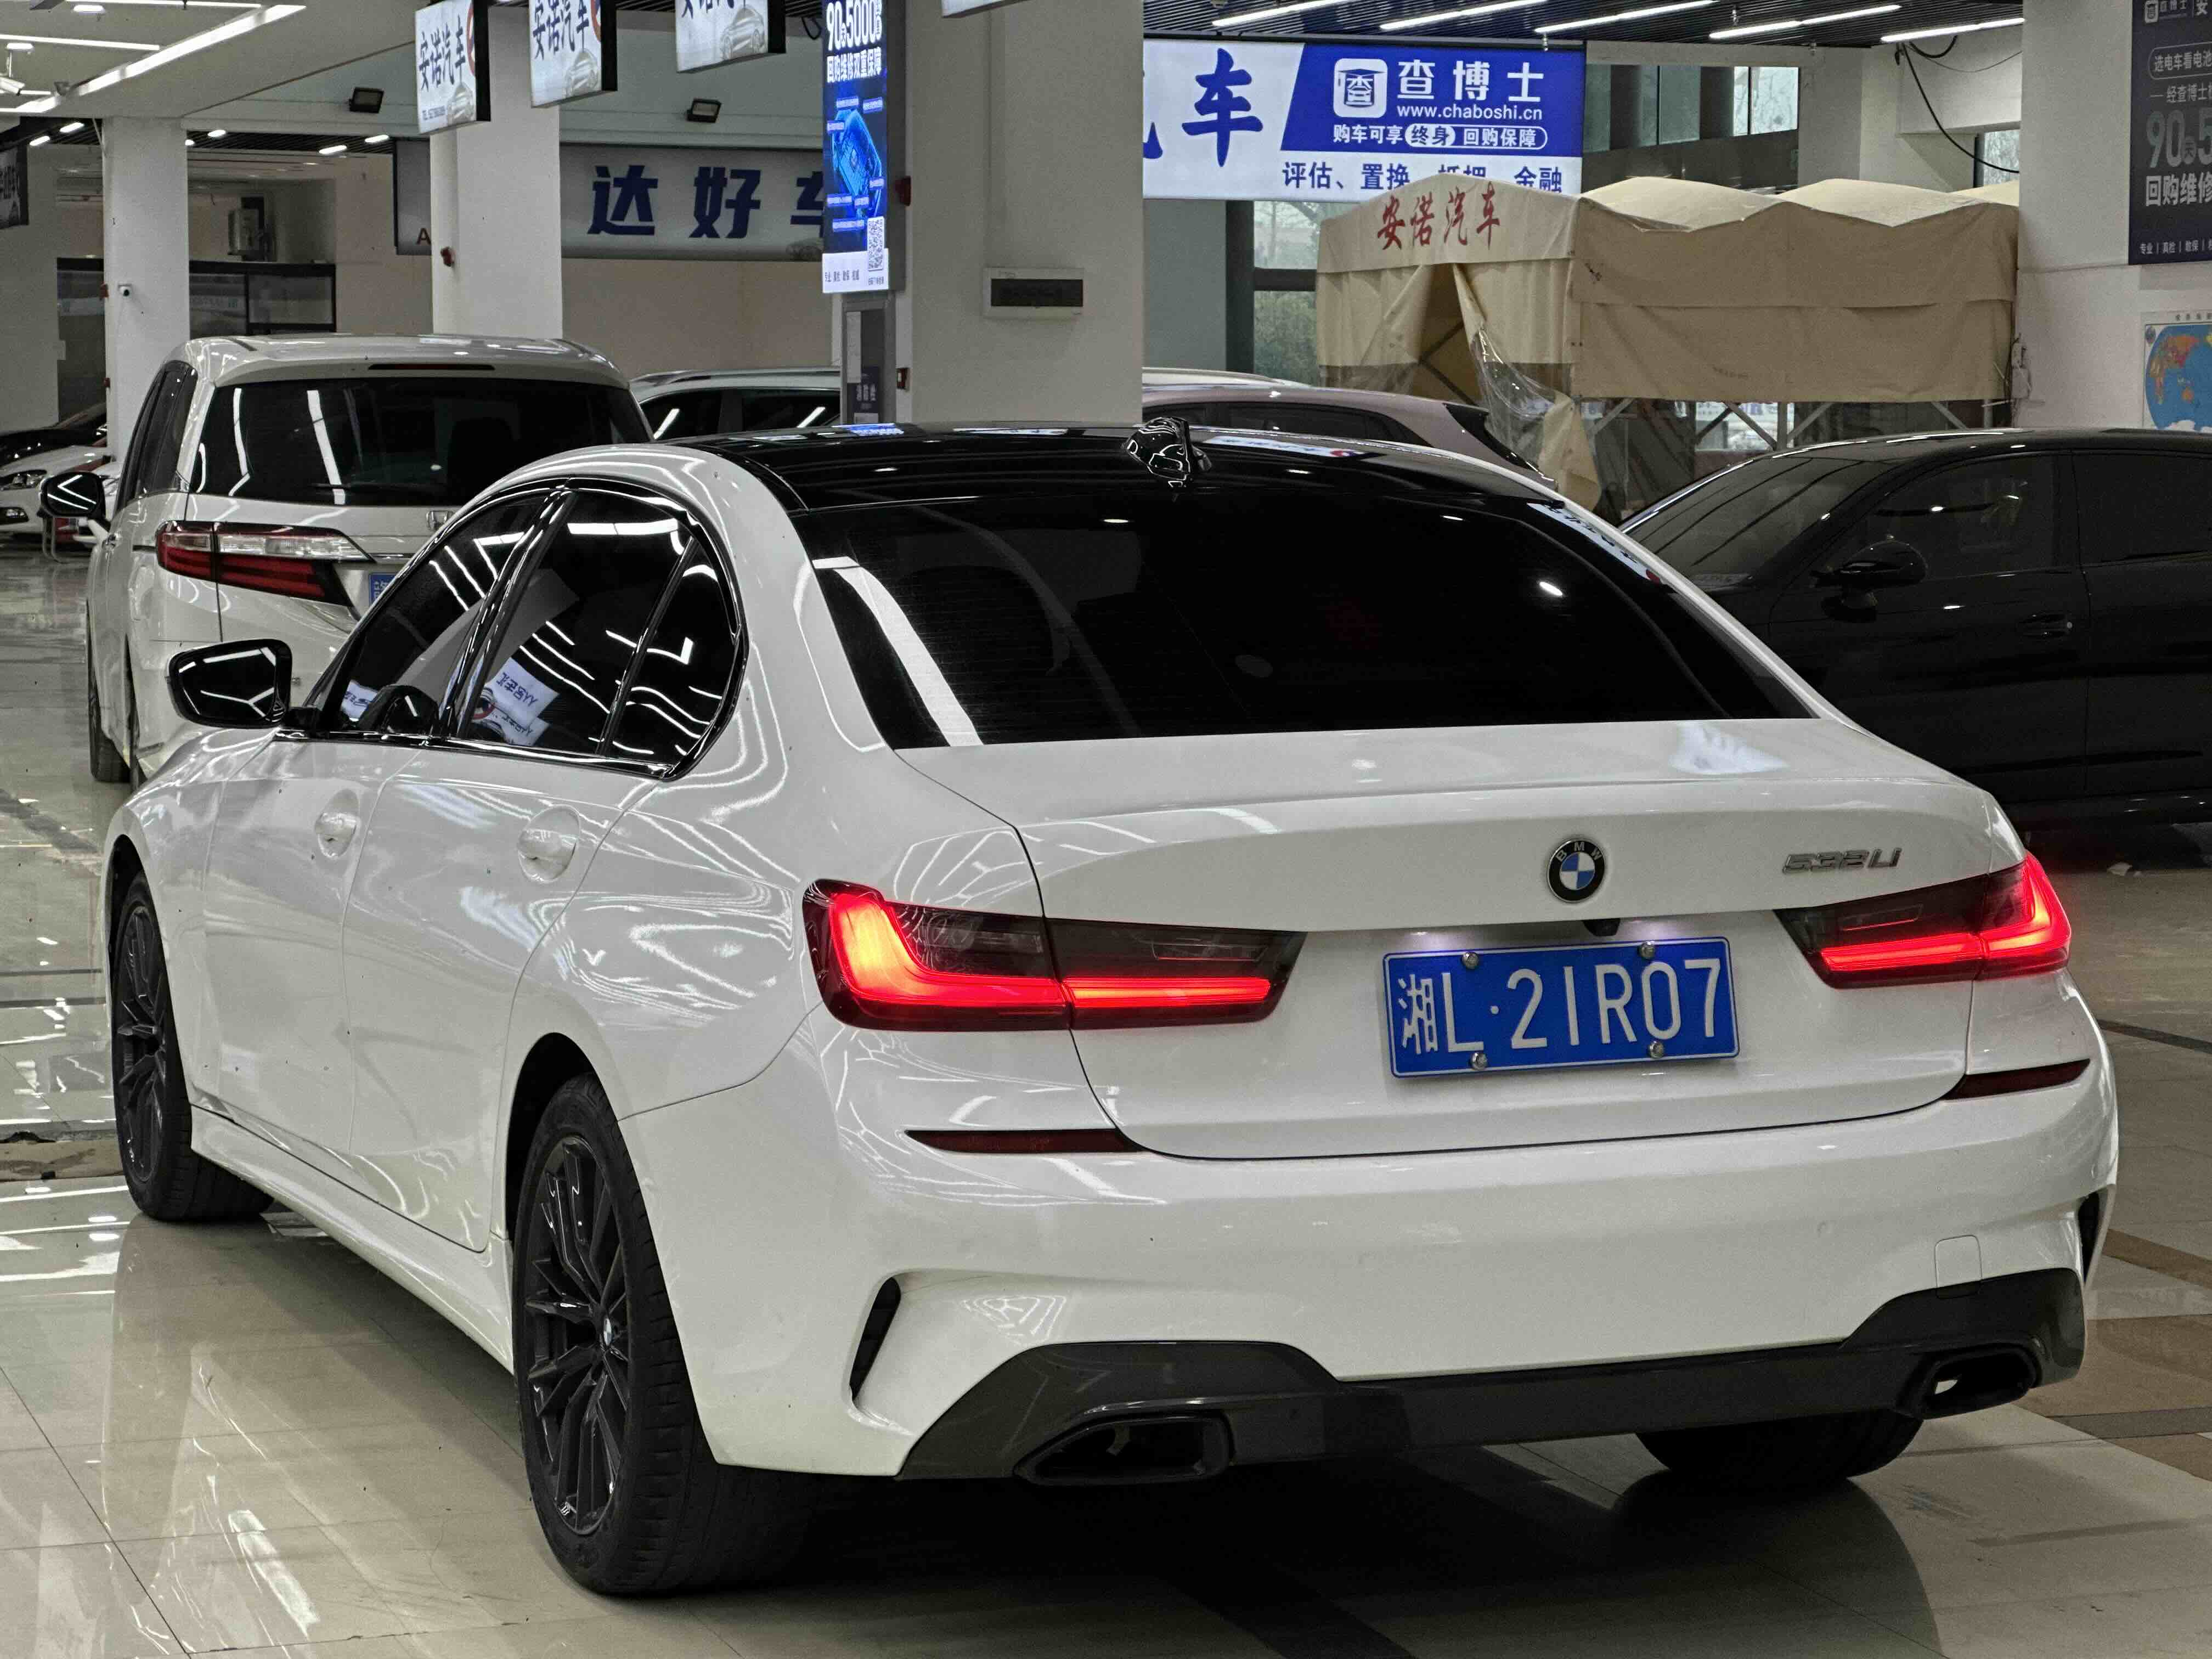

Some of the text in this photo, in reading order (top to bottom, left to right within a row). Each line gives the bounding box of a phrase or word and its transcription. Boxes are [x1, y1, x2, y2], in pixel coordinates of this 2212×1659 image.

[419, 14, 466, 92] 安诺汽车
[1397, 59, 1544, 103] 查博士
[1143, 48, 1263, 167] 车
[1397, 104, 1543, 121] www.chaboshi.cn
[2146, 172, 2212, 207] 回购维修
[1378, 181, 1500, 250] 安诺汽车
[1555, 841, 1603, 862] BMW
